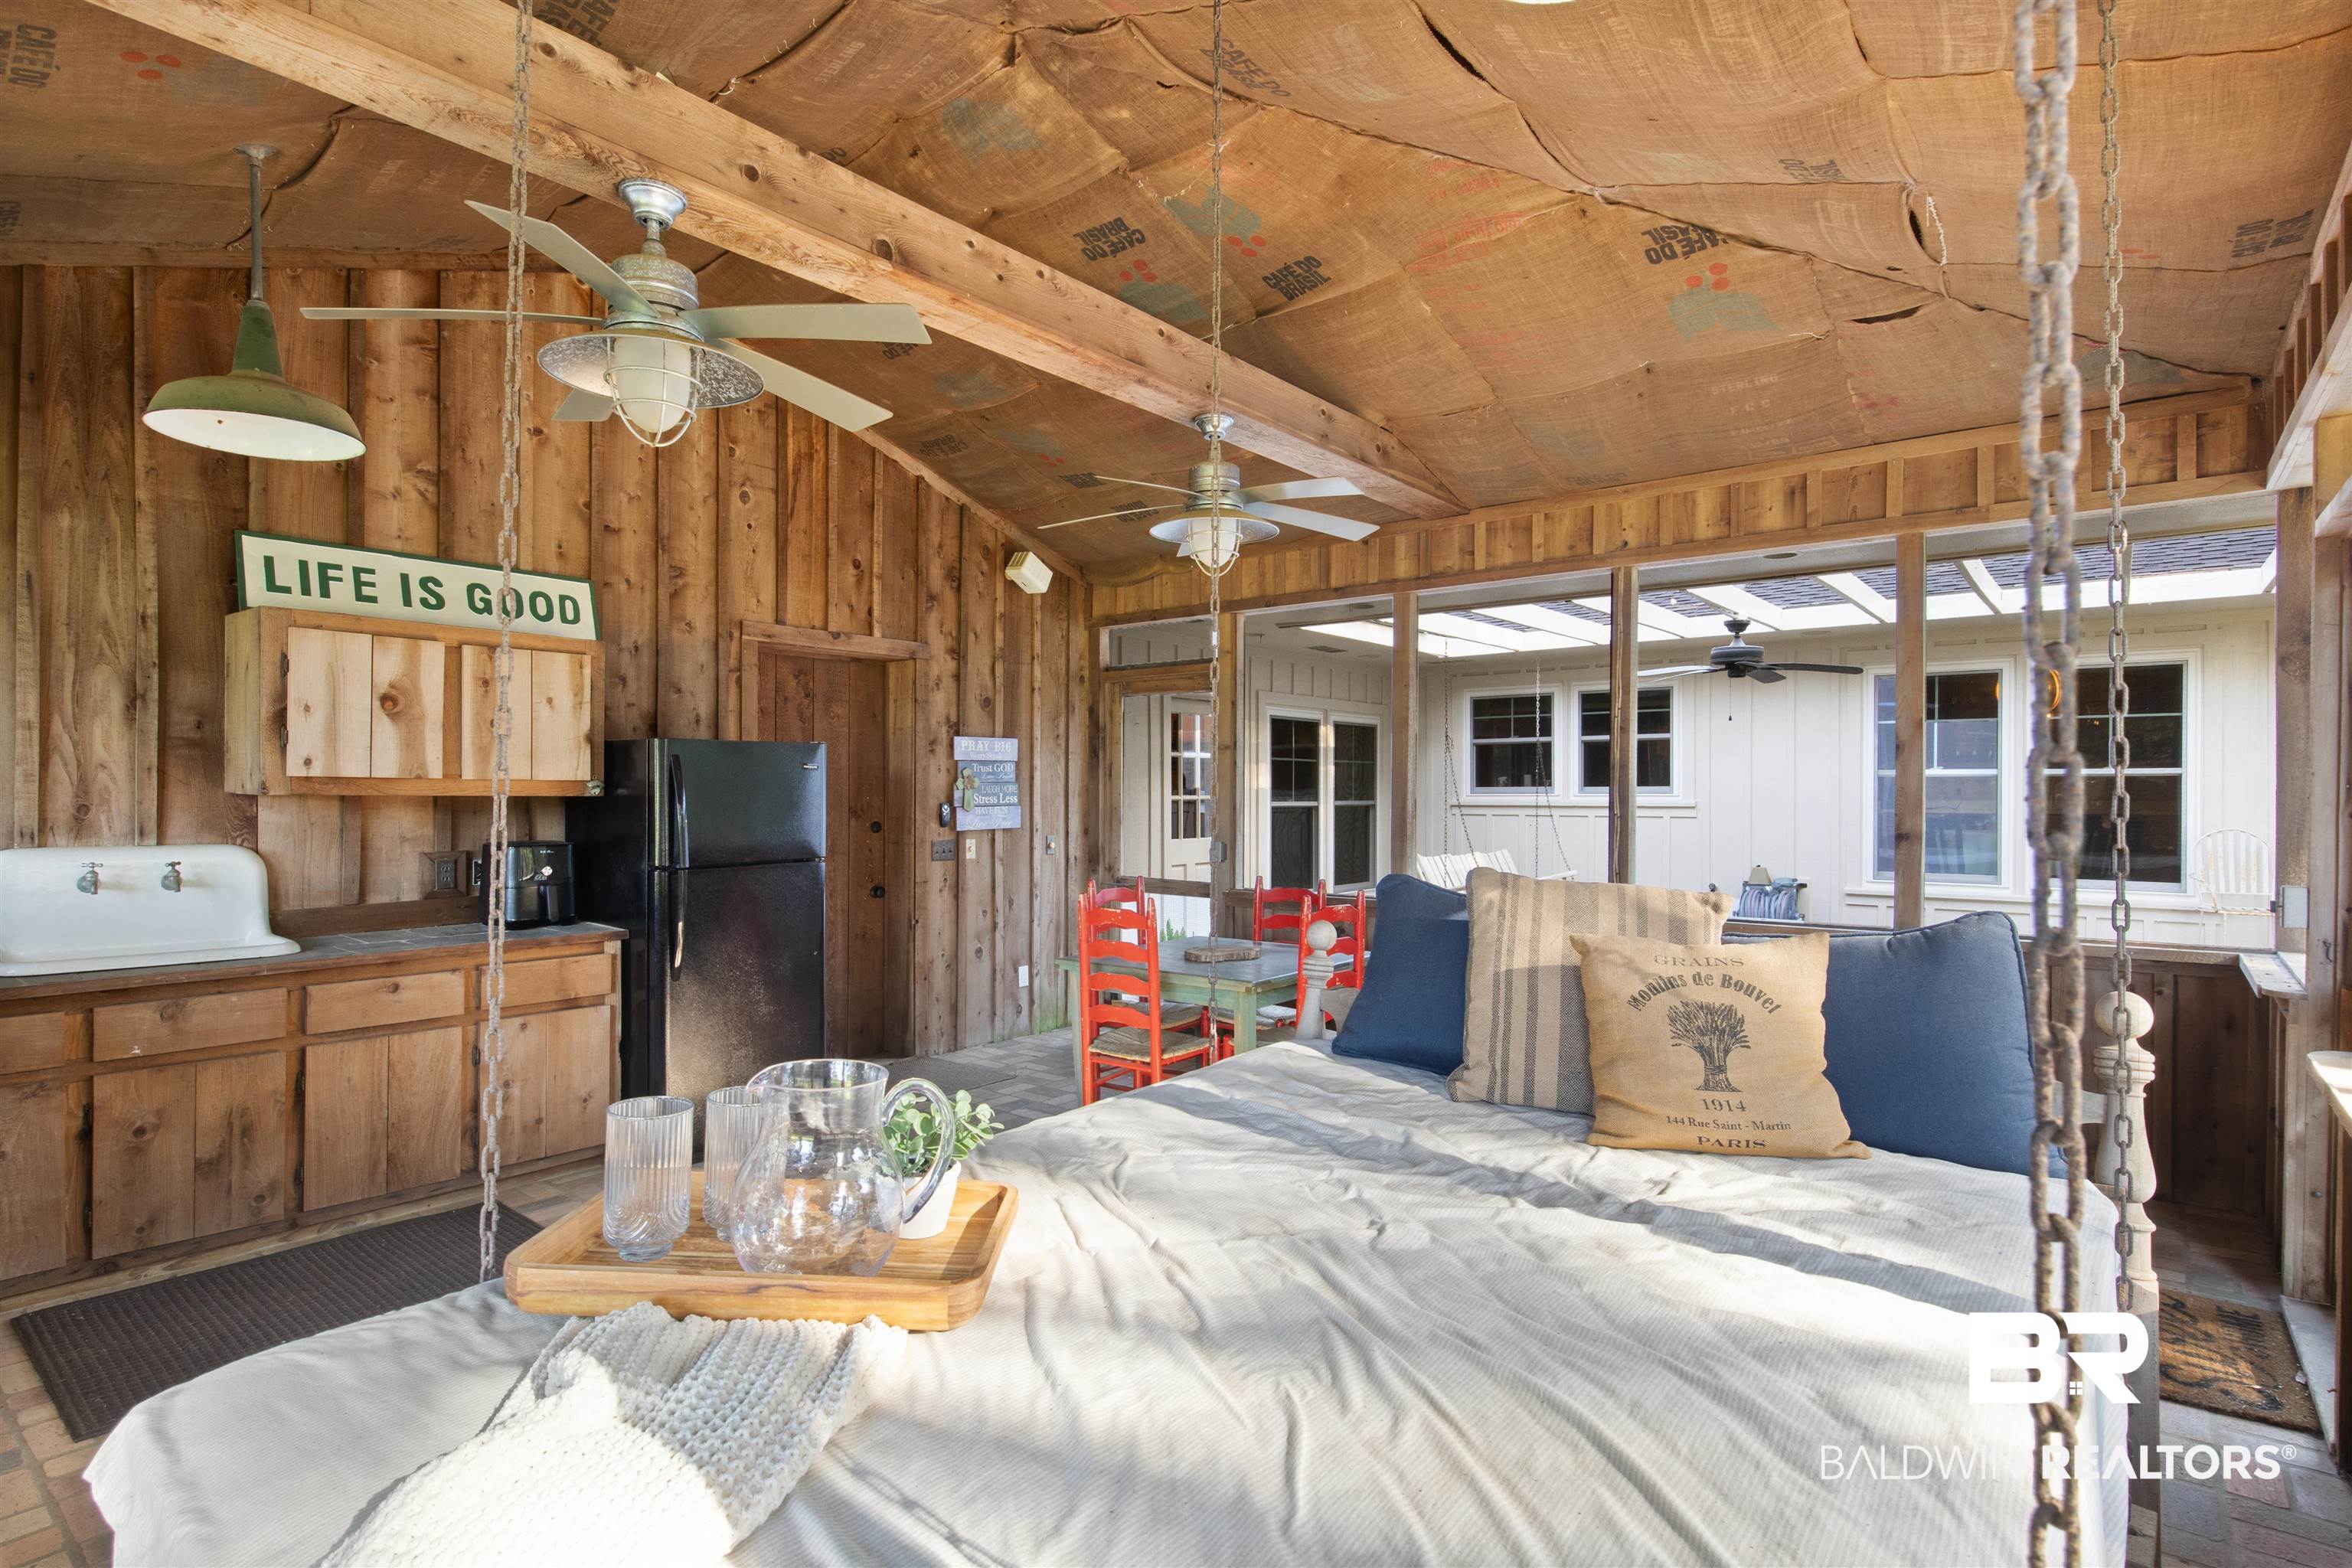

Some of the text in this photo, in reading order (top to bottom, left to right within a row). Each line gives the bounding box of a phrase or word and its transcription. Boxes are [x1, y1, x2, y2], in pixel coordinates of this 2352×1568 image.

[1073, 217, 1131, 246] BRASIL
[1080, 228, 1146, 262] CAFÉ DO
[1645, 242, 1679, 265] DO
[1262, 255, 1323, 290] CAFÉ DO
[1276, 271, 1331, 302] BRASIL
[263, 555, 581, 626] LIFE IS GOOD
[961, 740, 1011, 752] PRAY BIG
[972, 763, 1014, 773] Trust GOD
[1001, 784, 1018, 792] MORE
[973, 793, 1018, 804] Stress Less
[1654, 954, 1745, 968] GRAINS
[1626, 972, 1784, 1015] Moulins de Bouvet
[1701, 1099, 1747, 1112] 1914
[1665, 1116, 1686, 1127] 144
[1687, 1116, 1710, 1129] Rue
[1712, 1118, 1744, 1131] Saint
[1751, 1120, 1792, 1131] Martin
[1697, 1136, 1766, 1150] PARIS
